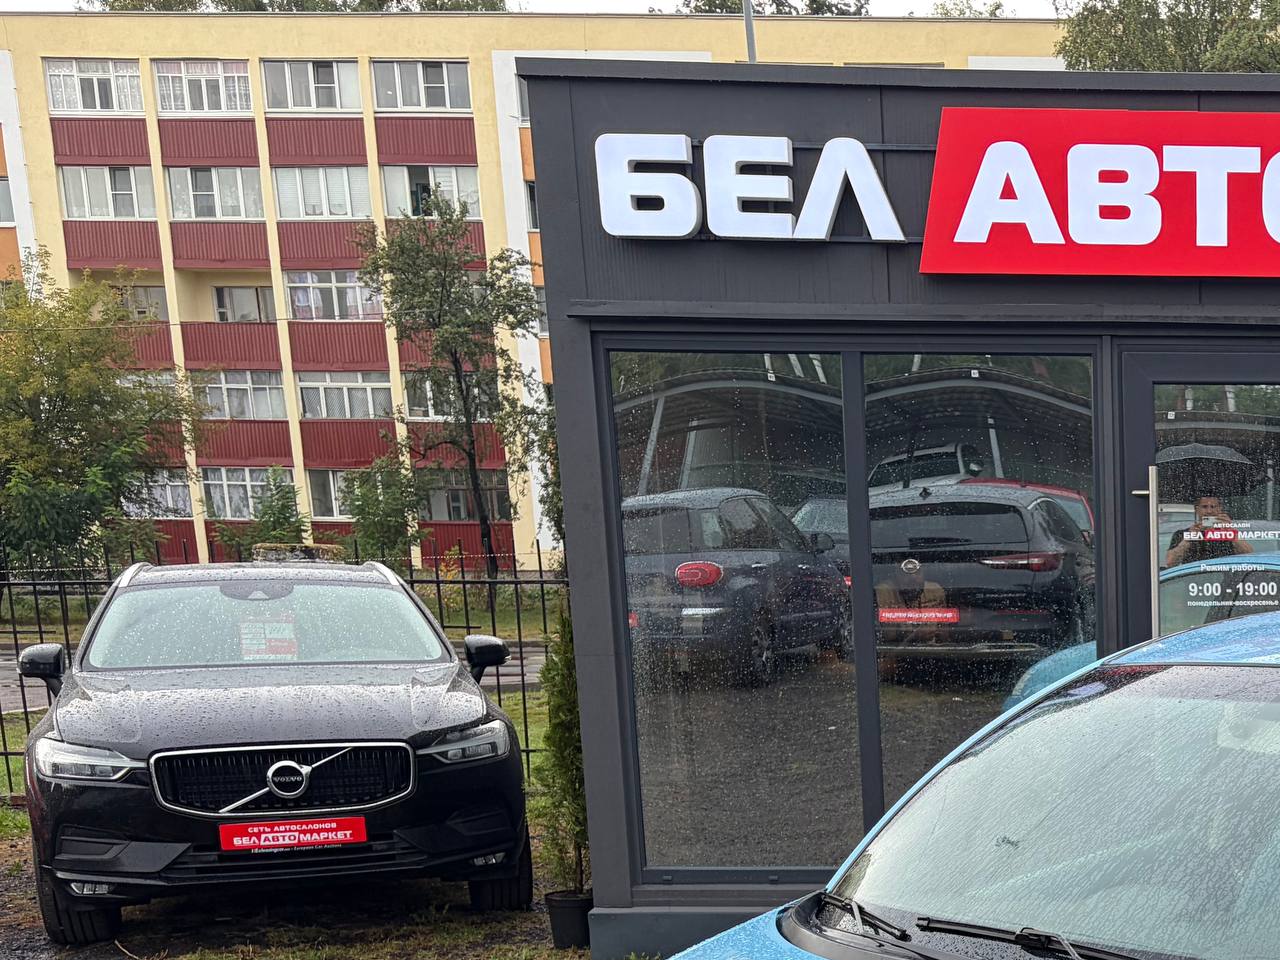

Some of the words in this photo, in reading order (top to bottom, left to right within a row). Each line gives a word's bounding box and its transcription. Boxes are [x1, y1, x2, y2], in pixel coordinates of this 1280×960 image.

[594, 133, 906, 242] БЕЛ
[1183, 531, 1204, 539] БЕЛ
[1206, 531, 1235, 539] АВТО
[1237, 531, 1280, 539] МАРКЕТ
[1200, 563, 1230, 572] Режим
[1232, 563, 1265, 573] работы
[1188, 582, 1222, 596] 9:00
[1236, 582, 1278, 596] 19:00
[273, 823, 337, 832] АВТОСАЛОНОВ
